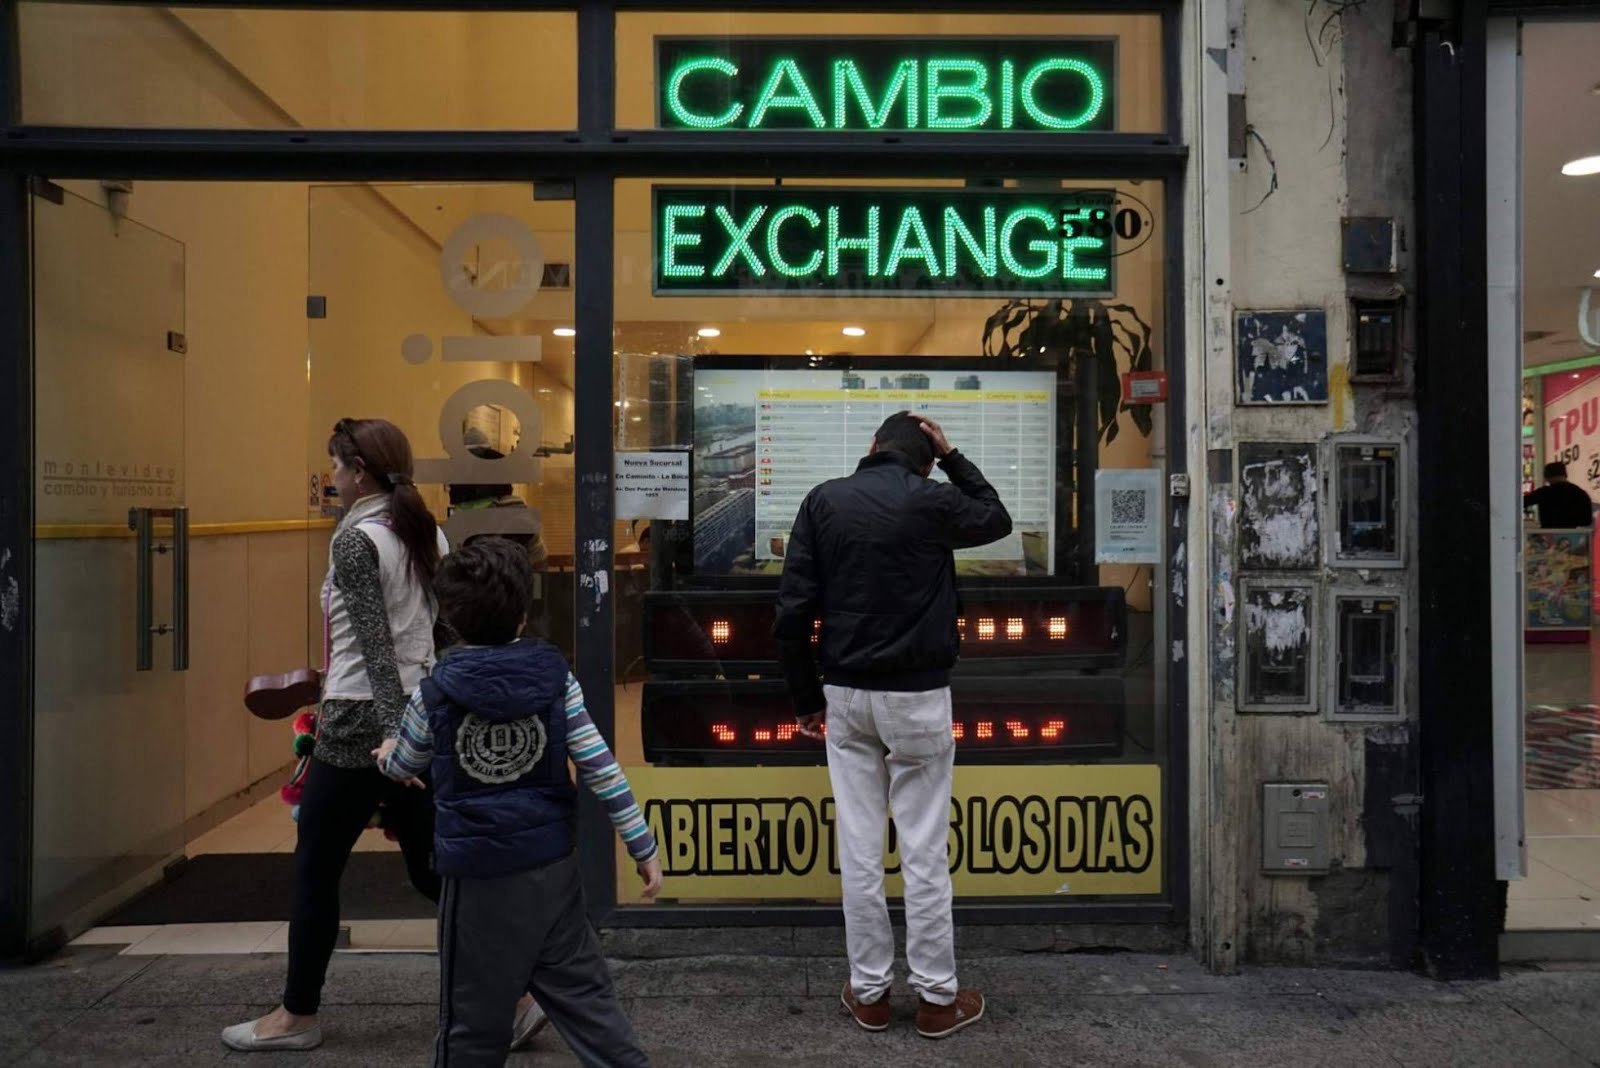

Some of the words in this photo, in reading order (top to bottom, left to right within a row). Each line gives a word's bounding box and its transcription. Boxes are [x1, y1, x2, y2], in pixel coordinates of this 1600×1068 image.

[667, 57, 1104, 129] CAMBIO
[662, 204, 1108, 279] EXCHANGE
[1058, 208, 1142, 239] 580
[1549, 397, 1599, 452] TPU
[649, 459, 683, 467] Sucursal
[644, 798, 817, 876] ABIERTO
[967, 795, 1051, 874] LOS
[1055, 794, 1154, 873] DIAS
